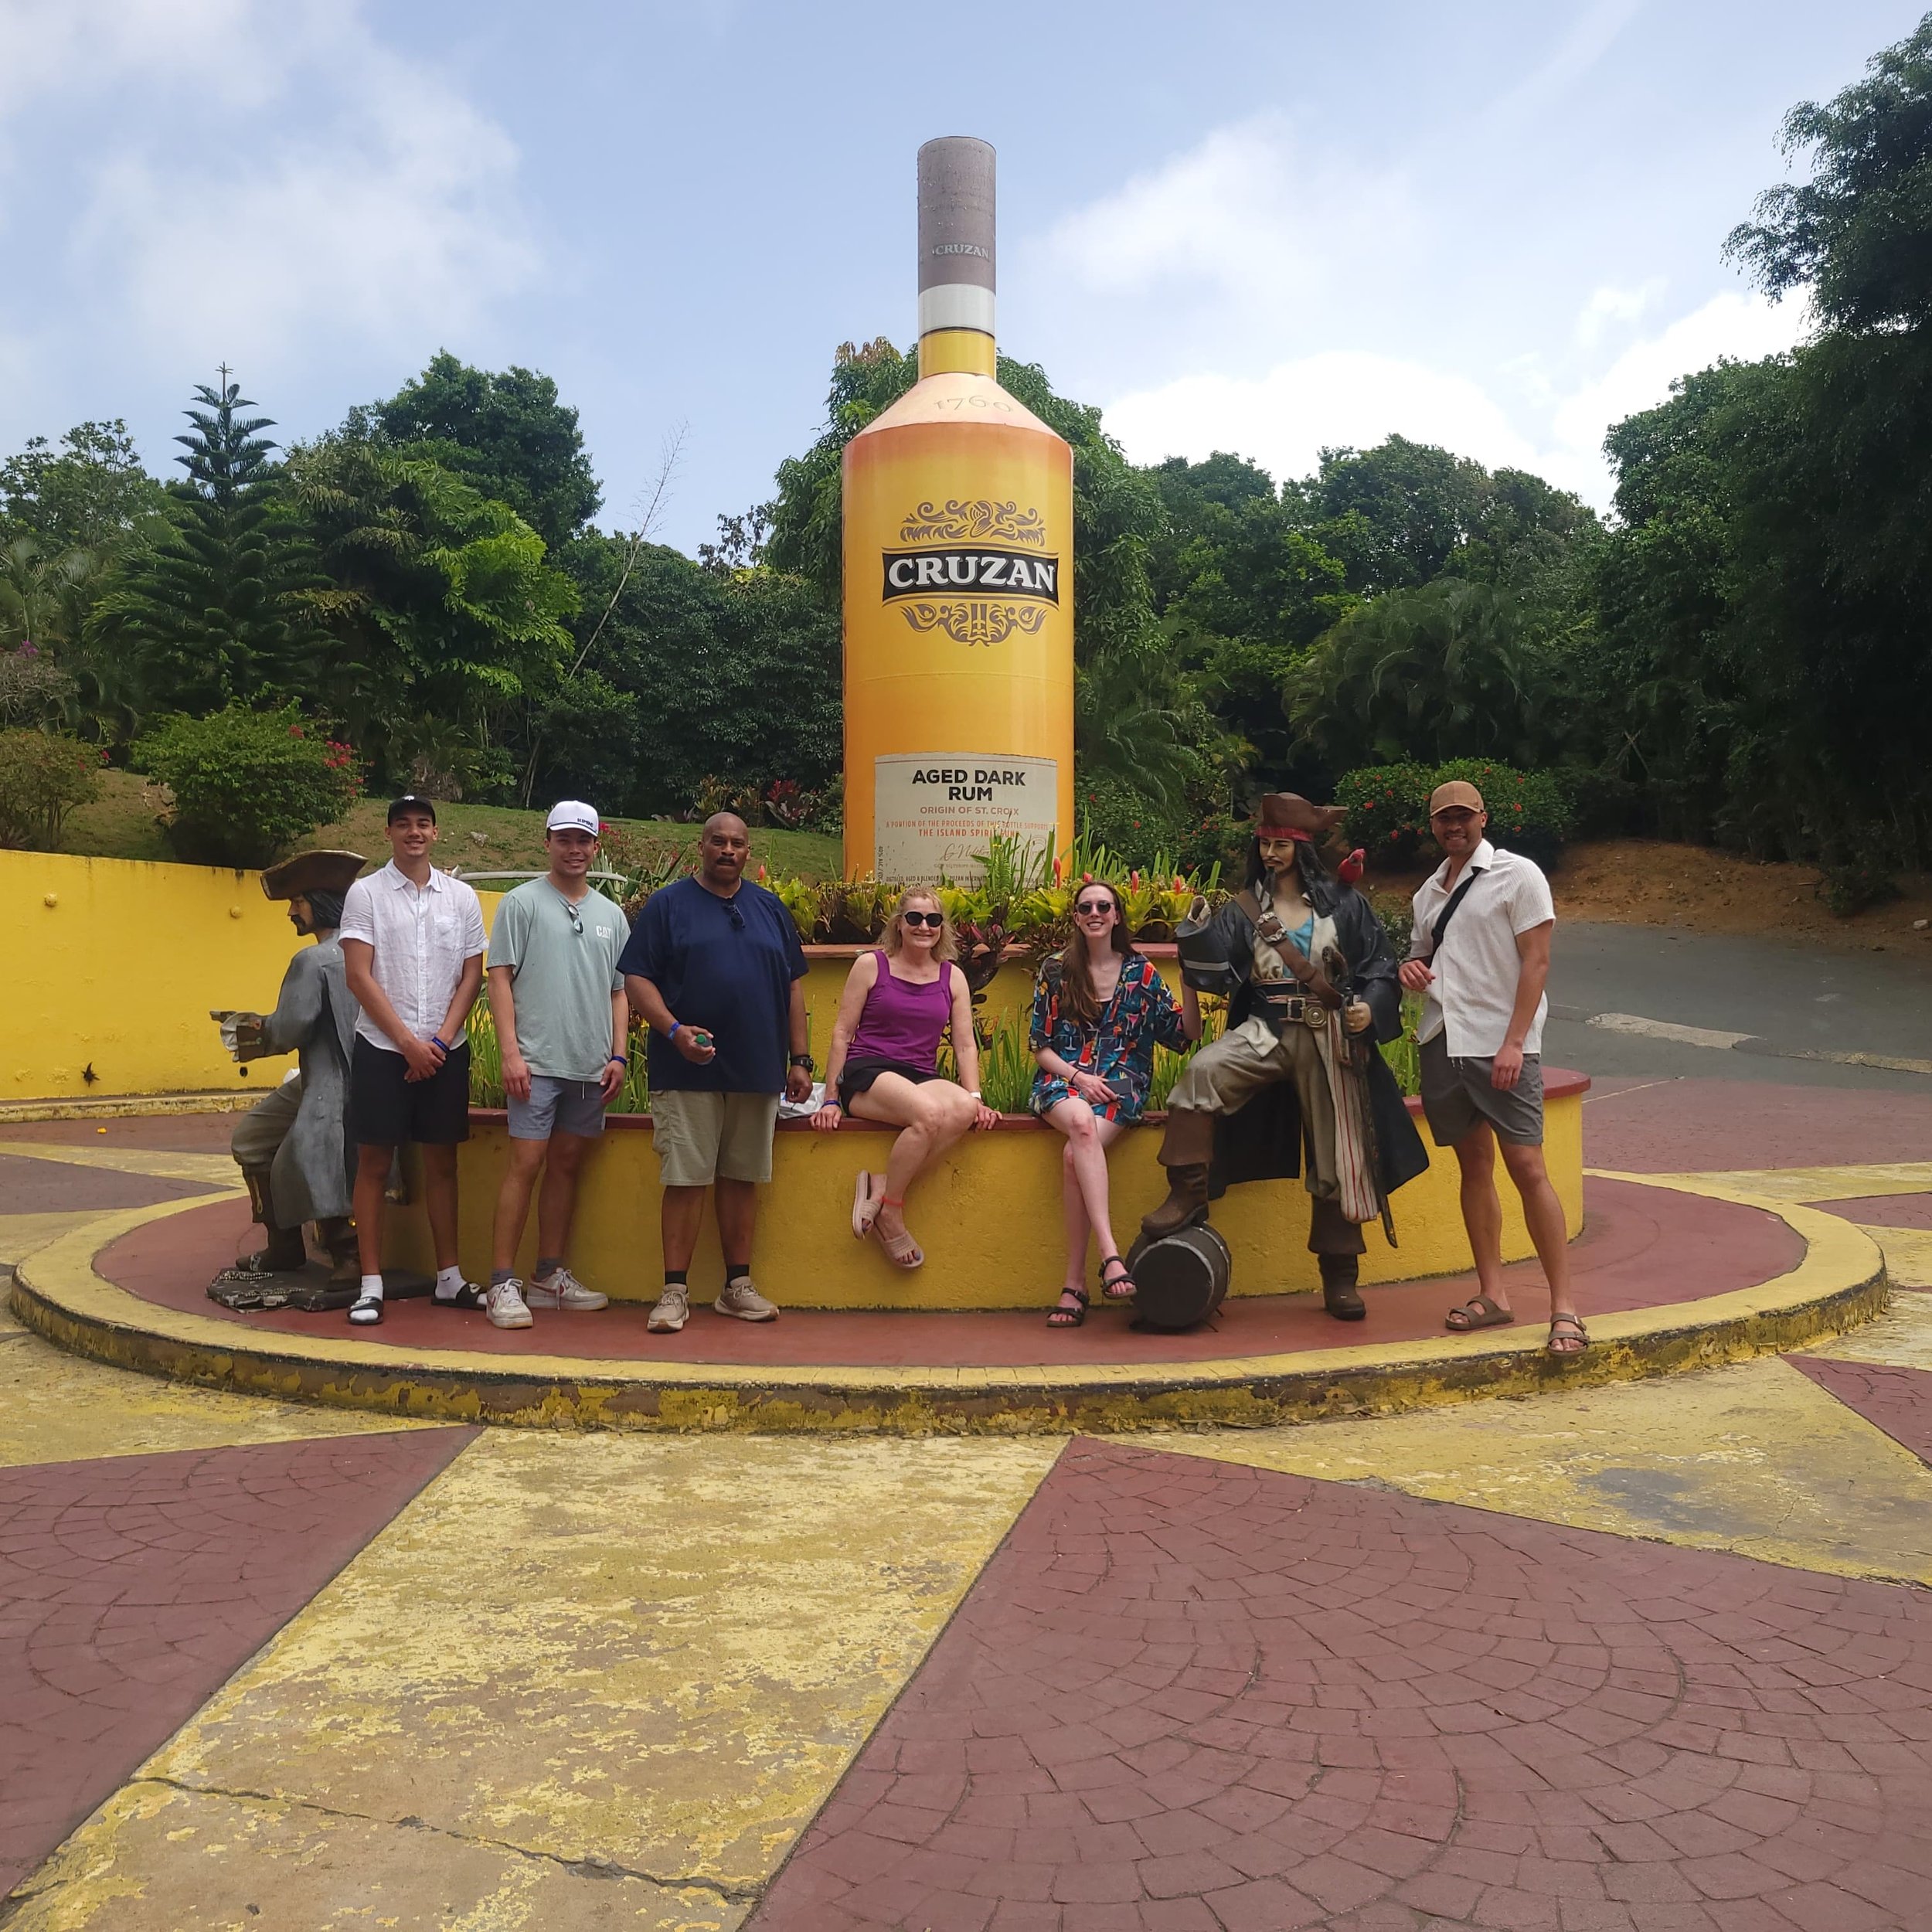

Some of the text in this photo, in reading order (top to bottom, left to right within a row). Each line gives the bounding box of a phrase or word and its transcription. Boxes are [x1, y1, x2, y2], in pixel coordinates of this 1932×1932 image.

[935, 243, 989, 259] CRUZAN
[934, 395, 1012, 412] 1760
[888, 556, 1056, 593] CRUZAN
[912, 769, 1026, 786] AGED DARK
[948, 786, 993, 801] RUM
[920, 806, 955, 815] ORIGIN
[958, 806, 972, 815] OF
[891, 820, 917, 828] PORTION
[928, 819, 940, 828] THE
[919, 828, 934, 837] THE
[937, 828, 967, 837] ISLAND
[596, 925, 611, 940] CAT
